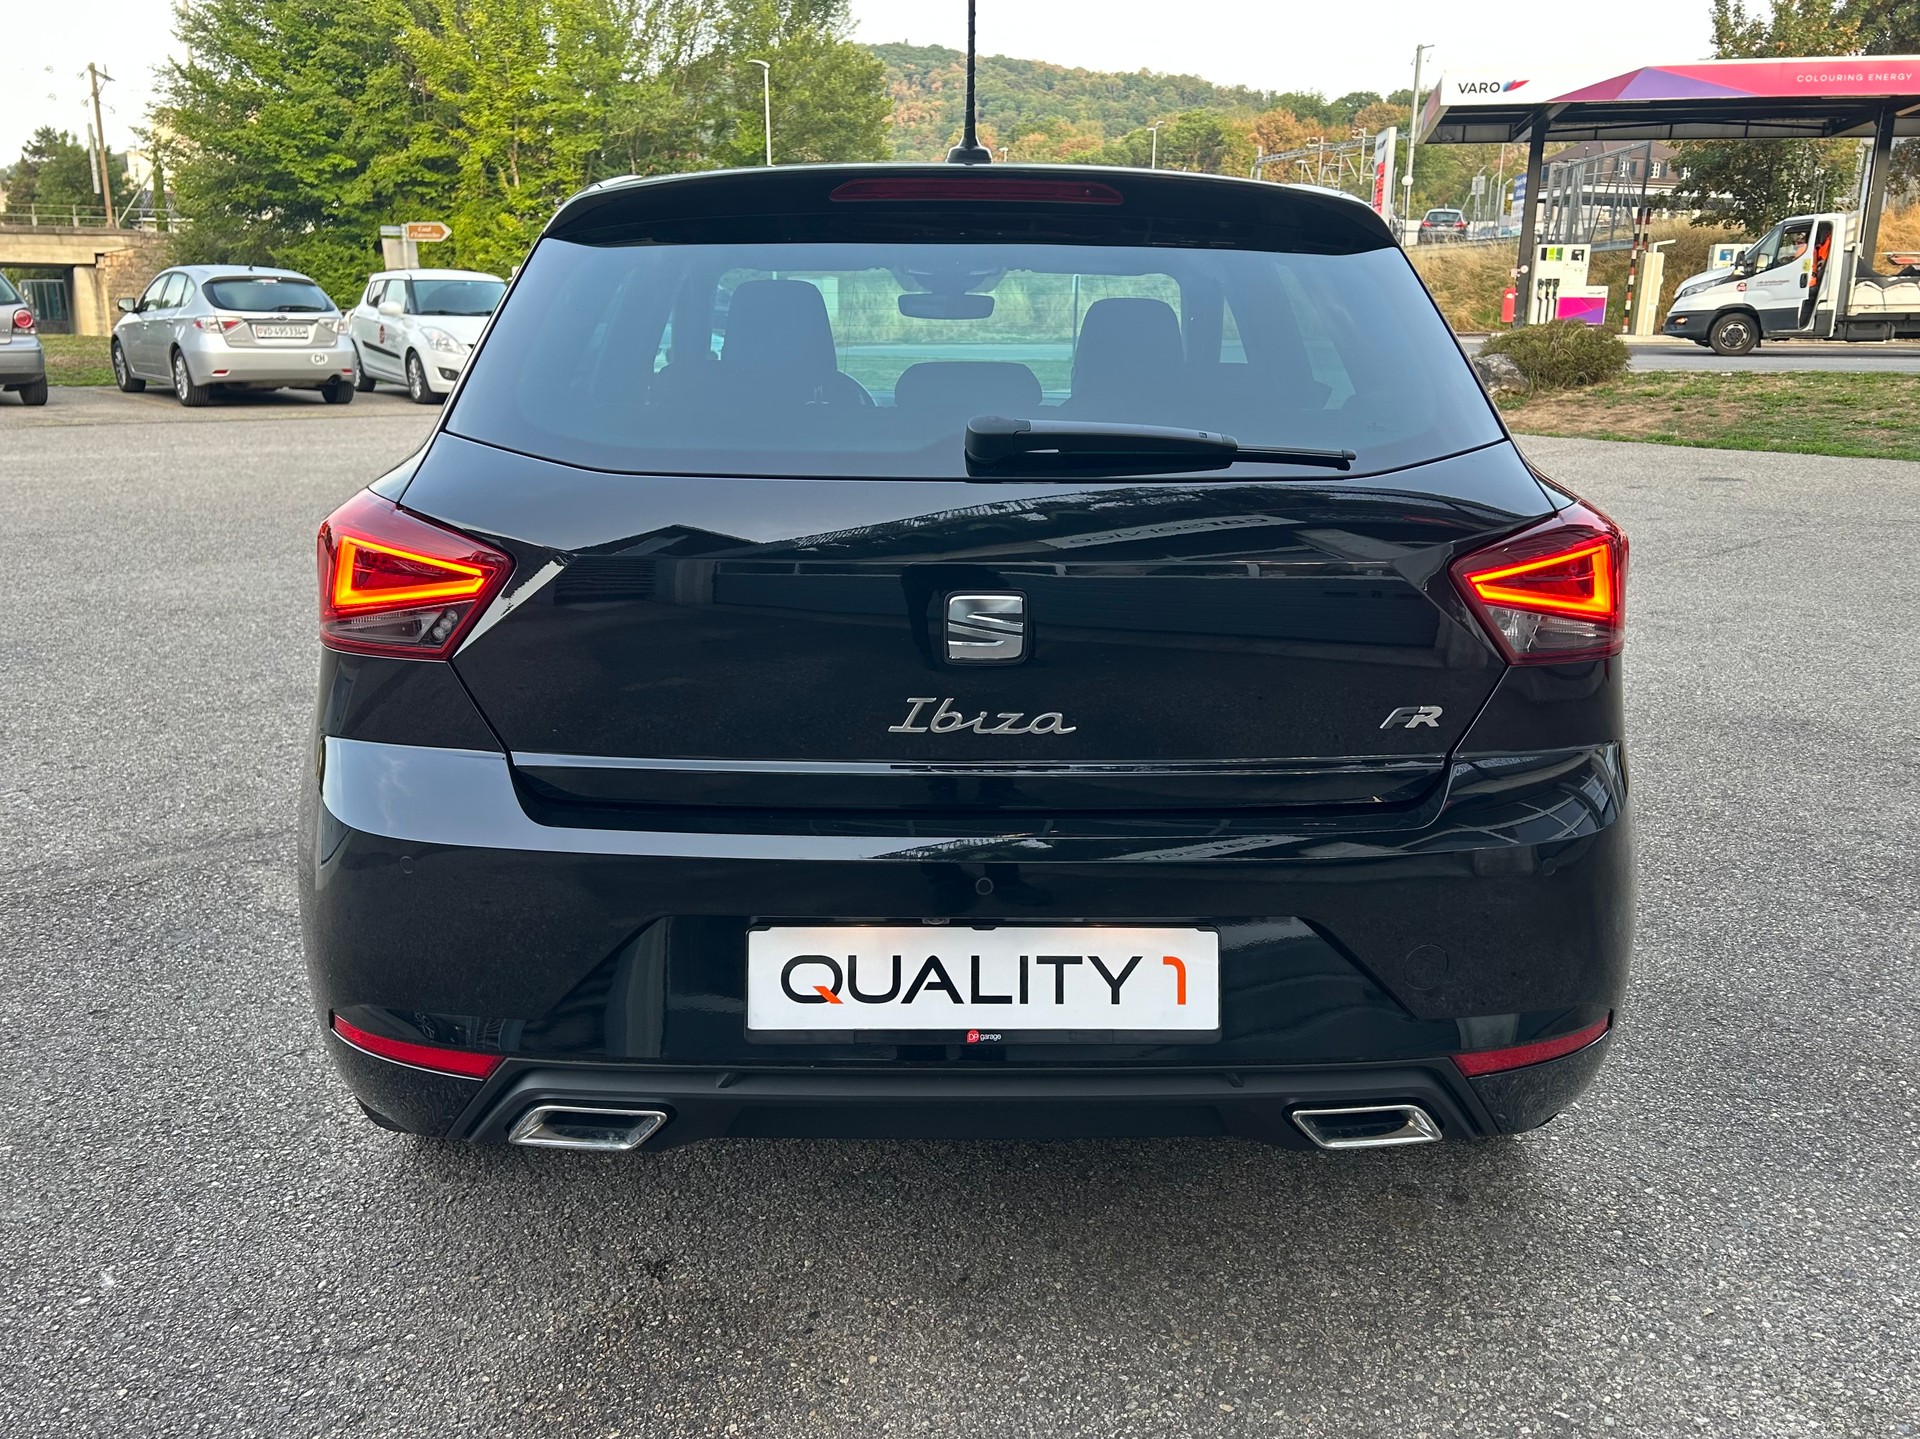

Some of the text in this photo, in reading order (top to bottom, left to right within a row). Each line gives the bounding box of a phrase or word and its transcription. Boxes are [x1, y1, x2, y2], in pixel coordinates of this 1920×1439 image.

[1796, 72, 1913, 83] COLOURING ENERGY
[1457, 81, 1500, 94] VARO
[314, 352, 325, 363] CH
[887, 697, 1077, 735] Ibiza
[1379, 705, 1443, 730] FR
[780, 954, 1187, 1005] QUALITY 1
[980, 1033, 1002, 1042] garage
